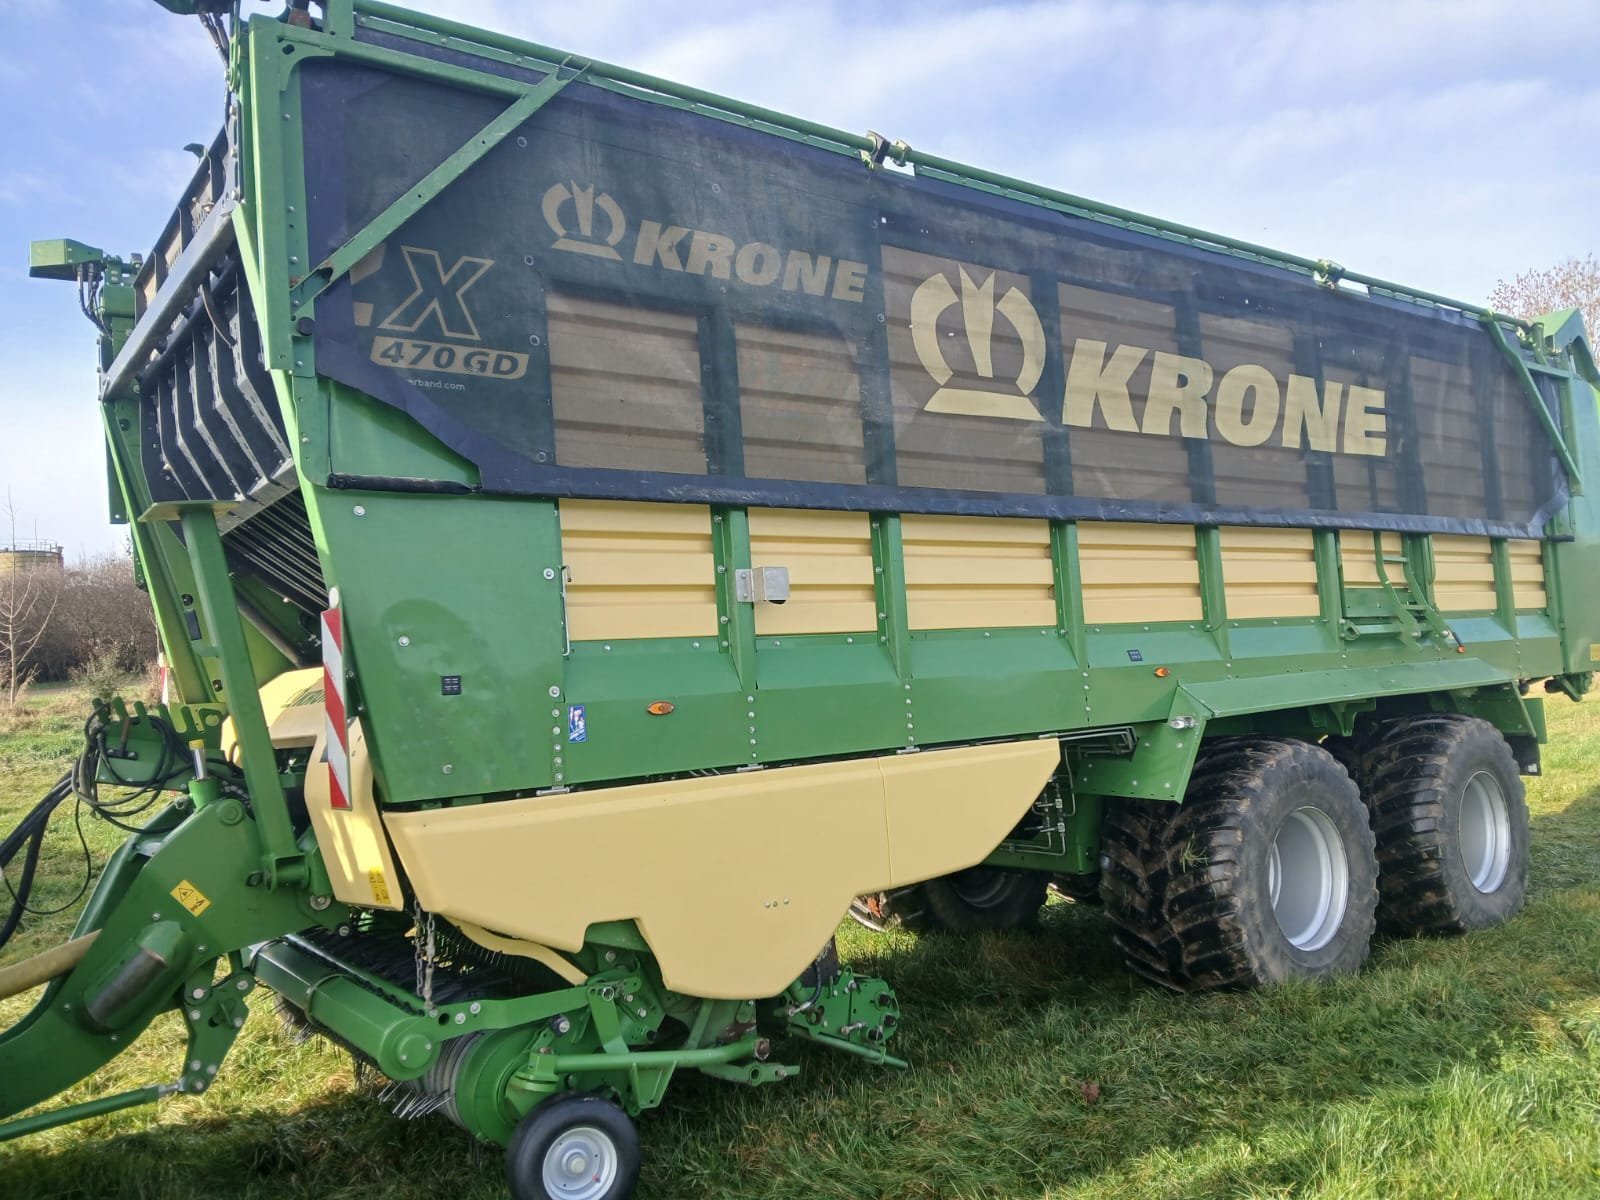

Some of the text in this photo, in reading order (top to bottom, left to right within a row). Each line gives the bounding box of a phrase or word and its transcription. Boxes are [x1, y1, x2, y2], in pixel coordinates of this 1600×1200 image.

[633, 219, 868, 303] KRONE
[380, 342, 520, 376] 470 GD
[1062, 338, 1387, 457] KRONE
